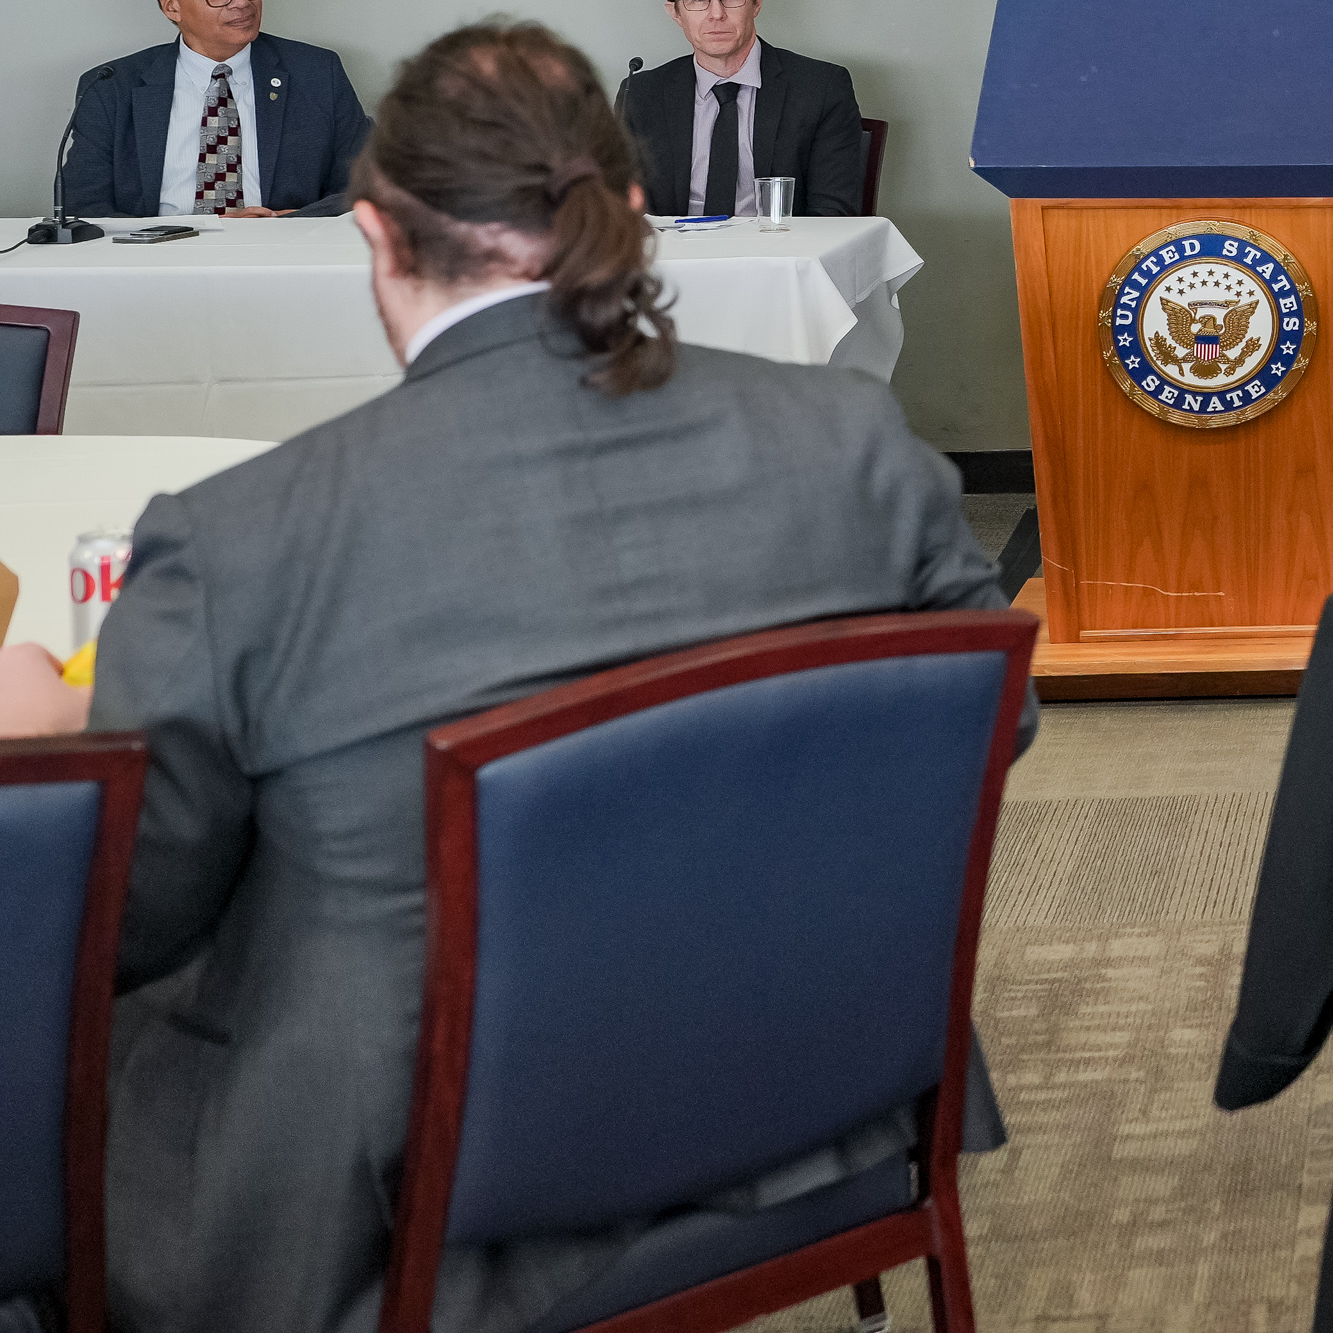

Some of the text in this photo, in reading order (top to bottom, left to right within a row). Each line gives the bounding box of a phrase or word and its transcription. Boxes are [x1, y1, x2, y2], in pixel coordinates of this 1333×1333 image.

[1115, 239, 1300, 332] UNITED STATES
[1141, 379, 1267, 413] SENATE
